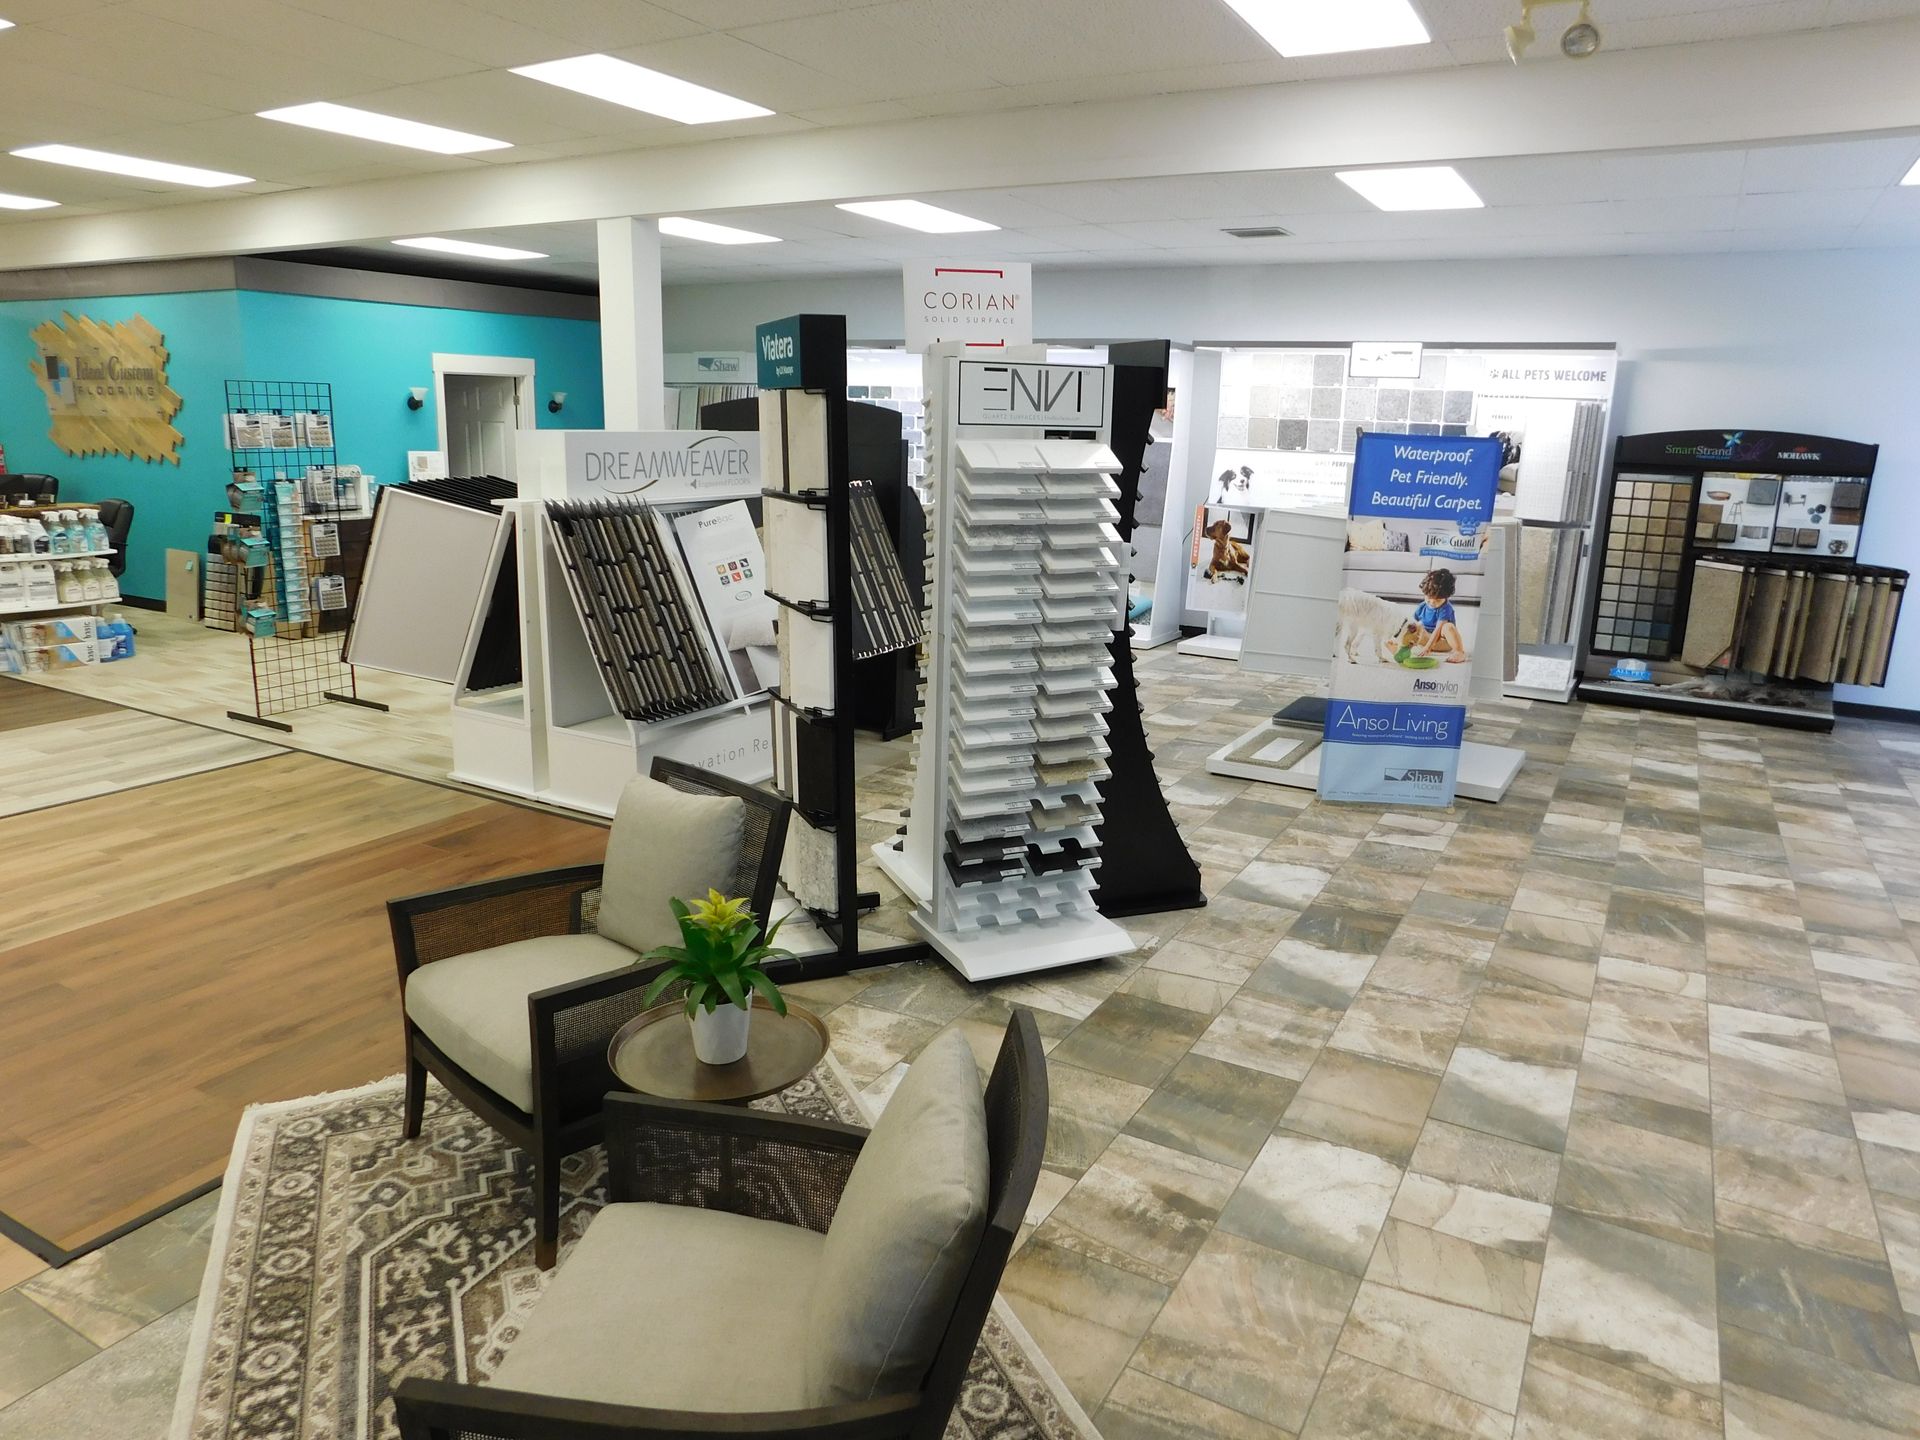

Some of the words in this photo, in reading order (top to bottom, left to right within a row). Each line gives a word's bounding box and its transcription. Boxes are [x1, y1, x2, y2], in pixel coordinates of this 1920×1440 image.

[924, 315, 959, 323] SOLID
[966, 316, 1015, 324] SURFACE
[762, 333, 794, 361] Viatera
[75, 356, 105, 381] Ideal
[108, 356, 154, 381] Custom
[713, 359, 738, 371] Shaw
[1501, 369, 1520, 380] ALL
[1524, 369, 1550, 381] PETS
[1553, 370, 1607, 382] WELCOME
[77, 385, 155, 397] FLOORING
[1394, 444, 1474, 467] Waterproof.
[1665, 444, 1732, 456] SmartStrand
[1777, 451, 1821, 461] MOHAWK
[585, 449, 750, 482] DREAMWEAVER
[1390, 468, 1411, 484] Pet
[1415, 470, 1468, 490] Friendly.
[1371, 491, 1431, 511] Beautiful
[1434, 494, 1482, 513] Carpet.
[1449, 535, 1476, 548] Guard
[1336, 705, 1389, 731] Anso
[1392, 707, 1449, 740] Living
[753, 738, 769, 752] Re
[1407, 770, 1443, 783] Shaw
[1413, 783, 1443, 791] FLOORS
